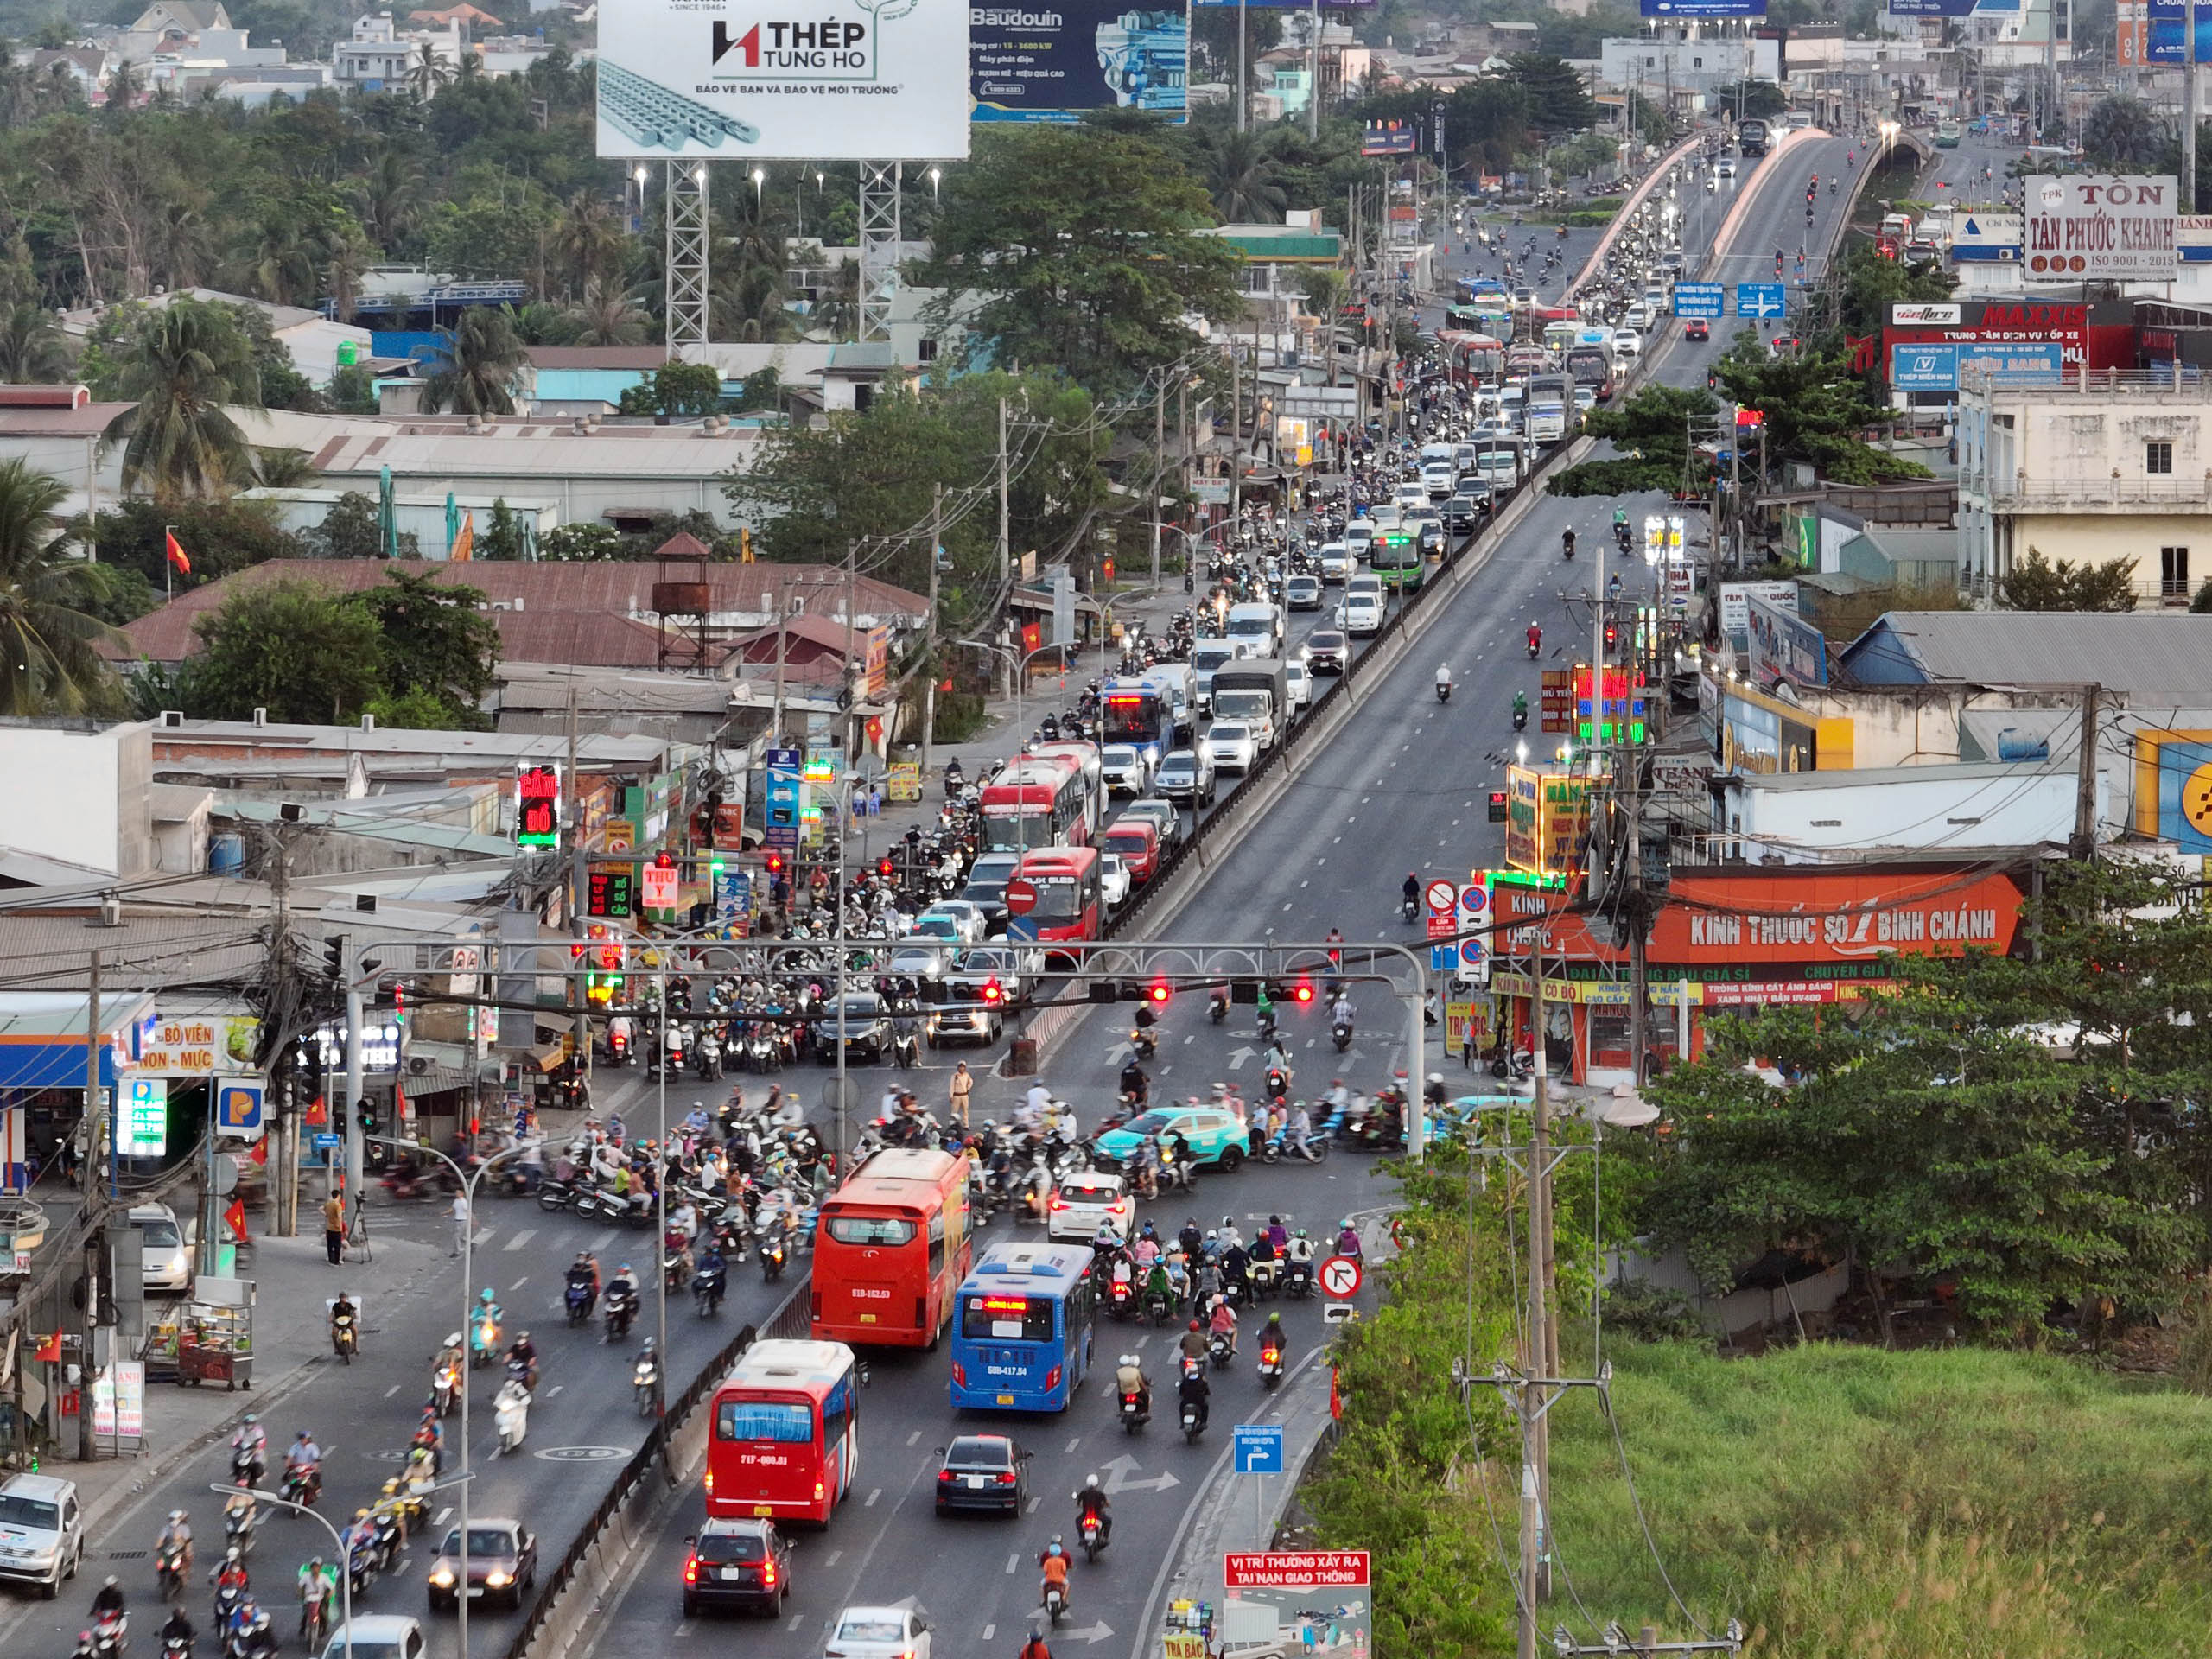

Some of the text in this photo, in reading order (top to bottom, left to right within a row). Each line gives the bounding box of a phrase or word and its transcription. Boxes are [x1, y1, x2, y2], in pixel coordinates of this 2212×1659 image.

[969, 8, 1063, 26] Baudouin
[767, 16, 865, 49] THÉP
[764, 51, 866, 68] TUNG HO
[2041, 189, 2063, 200] TPK
[2077, 178, 2164, 205] TÔN
[2030, 207, 2174, 251] TÂN PHƯỚC KHANH
[2091, 256, 2174, 266] ISO 9001 2015
[1982, 304, 2088, 326] MAXXIS
[1770, 590, 1796, 601] QUỐC
[520, 767, 557, 798] CẦM
[1511, 891, 1546, 914] KÍNH
[1929, 902, 1996, 941] CHÁNH
[1808, 981, 1833, 991] SÁNG
[165, 1022, 214, 1045] BÒ VIÊN
[180, 1049, 213, 1072] MỰC
[1231, 1553, 1361, 1570] VỊ TRÍ THƯỜNG XẢY RA
[1236, 1570, 1356, 1586] TAI NẠN GIAO THÔNG
